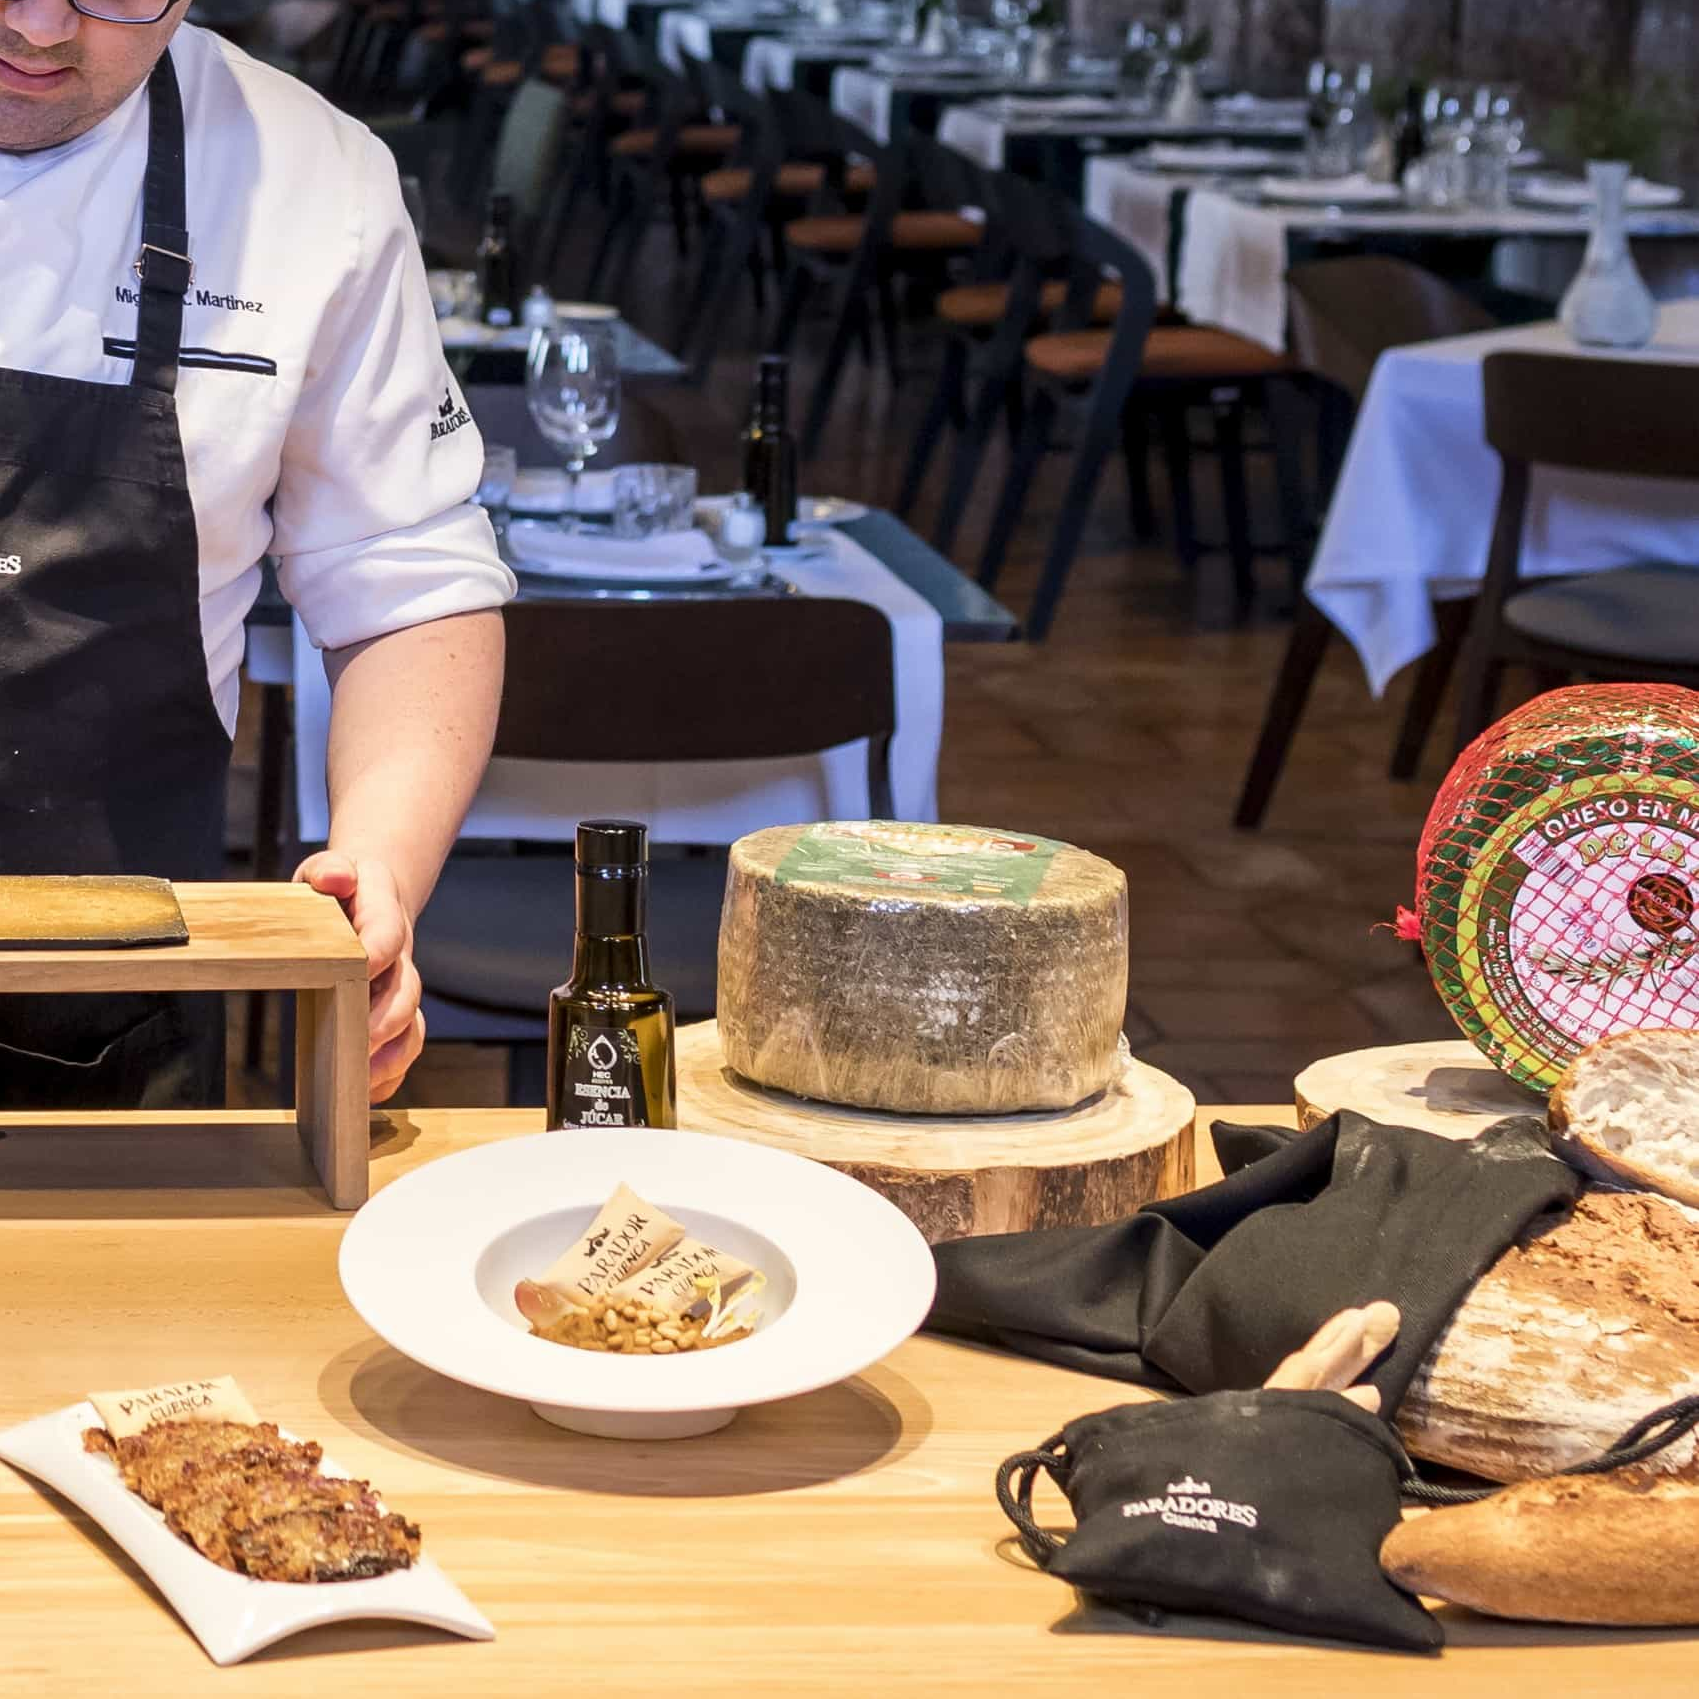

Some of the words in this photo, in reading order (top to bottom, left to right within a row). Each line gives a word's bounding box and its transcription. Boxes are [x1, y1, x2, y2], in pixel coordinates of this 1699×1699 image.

[116, 285, 142, 307] Mig
[1544, 797, 1630, 840] QUESO
[1636, 798, 1672, 821] EN
[580, 1109, 625, 1126] JÚCAR
[577, 1213, 650, 1296] PARADOR
[606, 1239, 652, 1289] CUENCA
[149, 1394, 214, 1422] CUENCA
[1121, 1495, 1258, 1528] PARADORES
